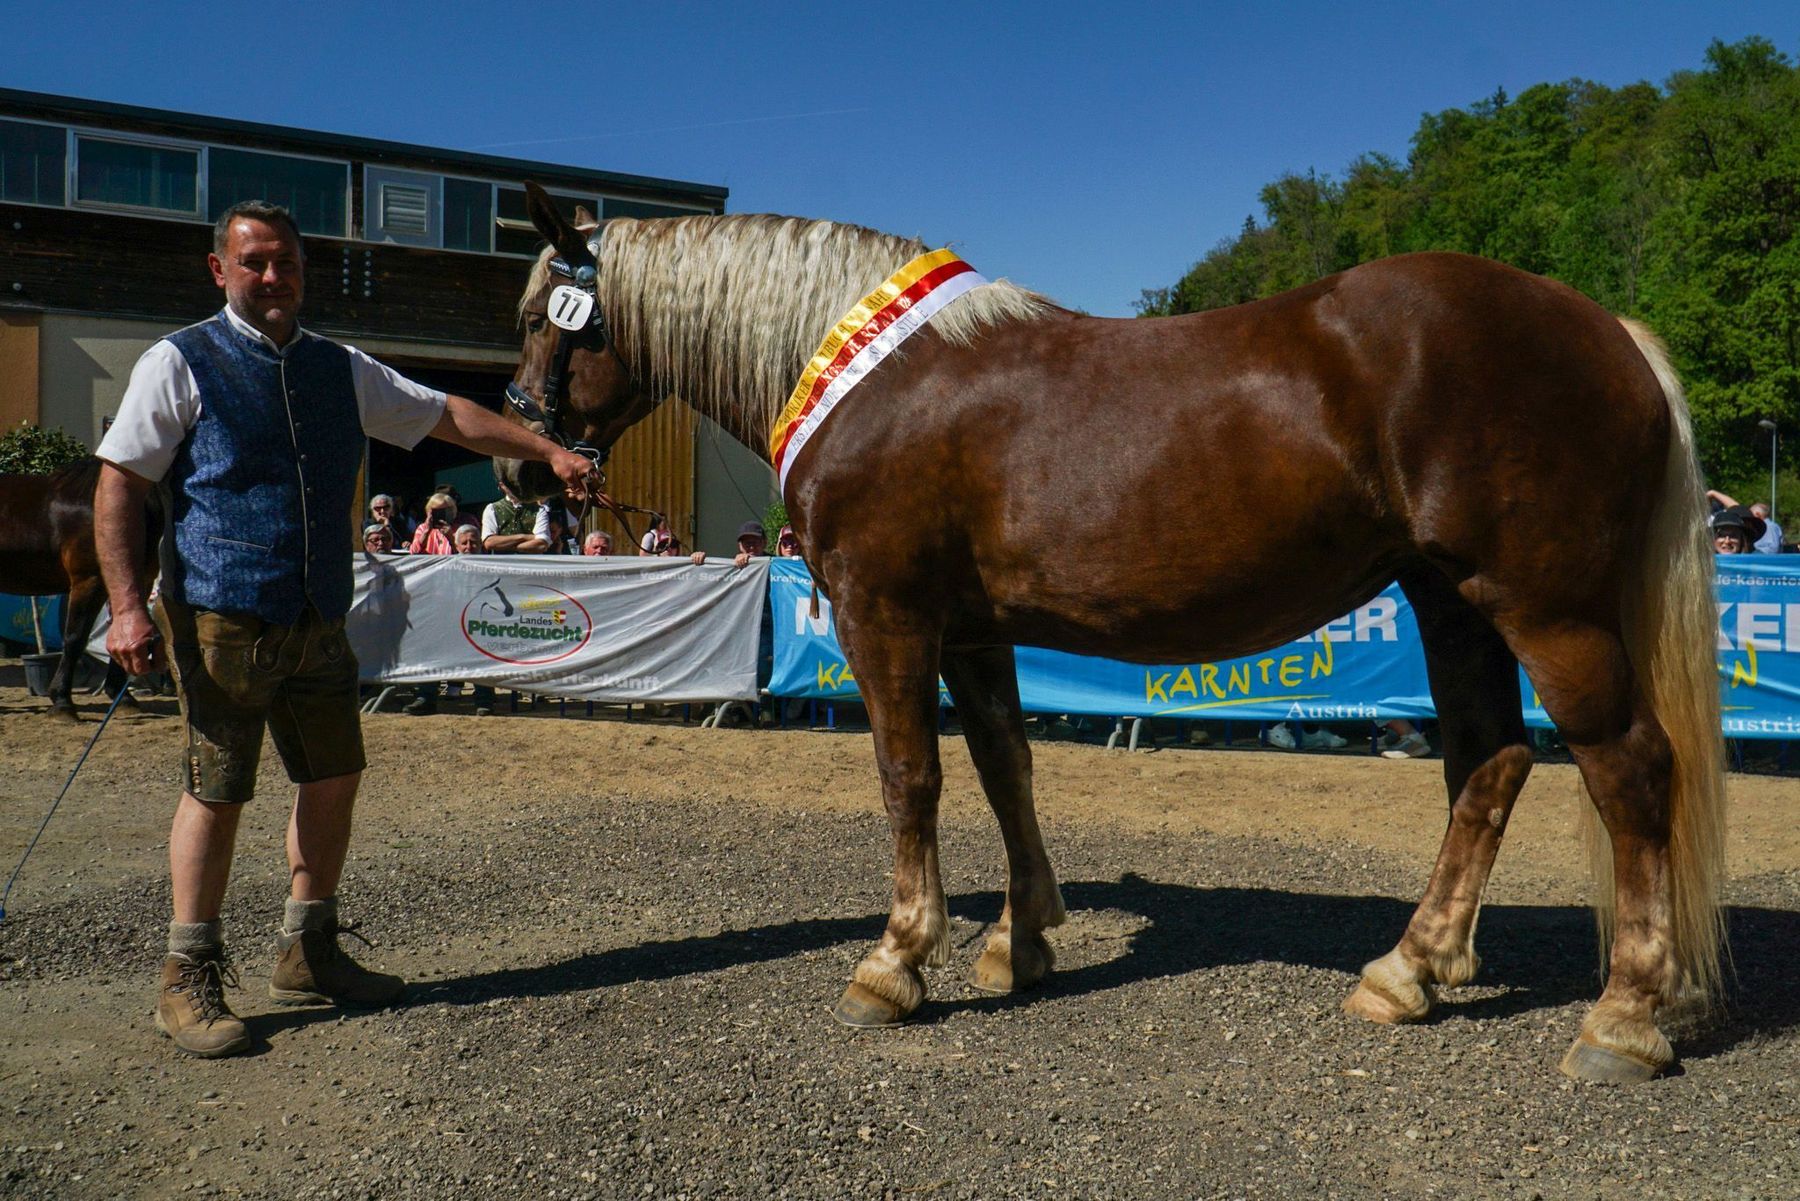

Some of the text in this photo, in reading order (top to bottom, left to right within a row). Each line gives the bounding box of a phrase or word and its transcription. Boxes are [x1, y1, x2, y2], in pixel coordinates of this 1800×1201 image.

[556, 292, 583, 322] 77
[519, 615, 553, 626] Landes
[468, 619, 583, 642] Pferdezucht
[1286, 701, 1378, 719] Austria
[1721, 715, 1800, 733] ustria
